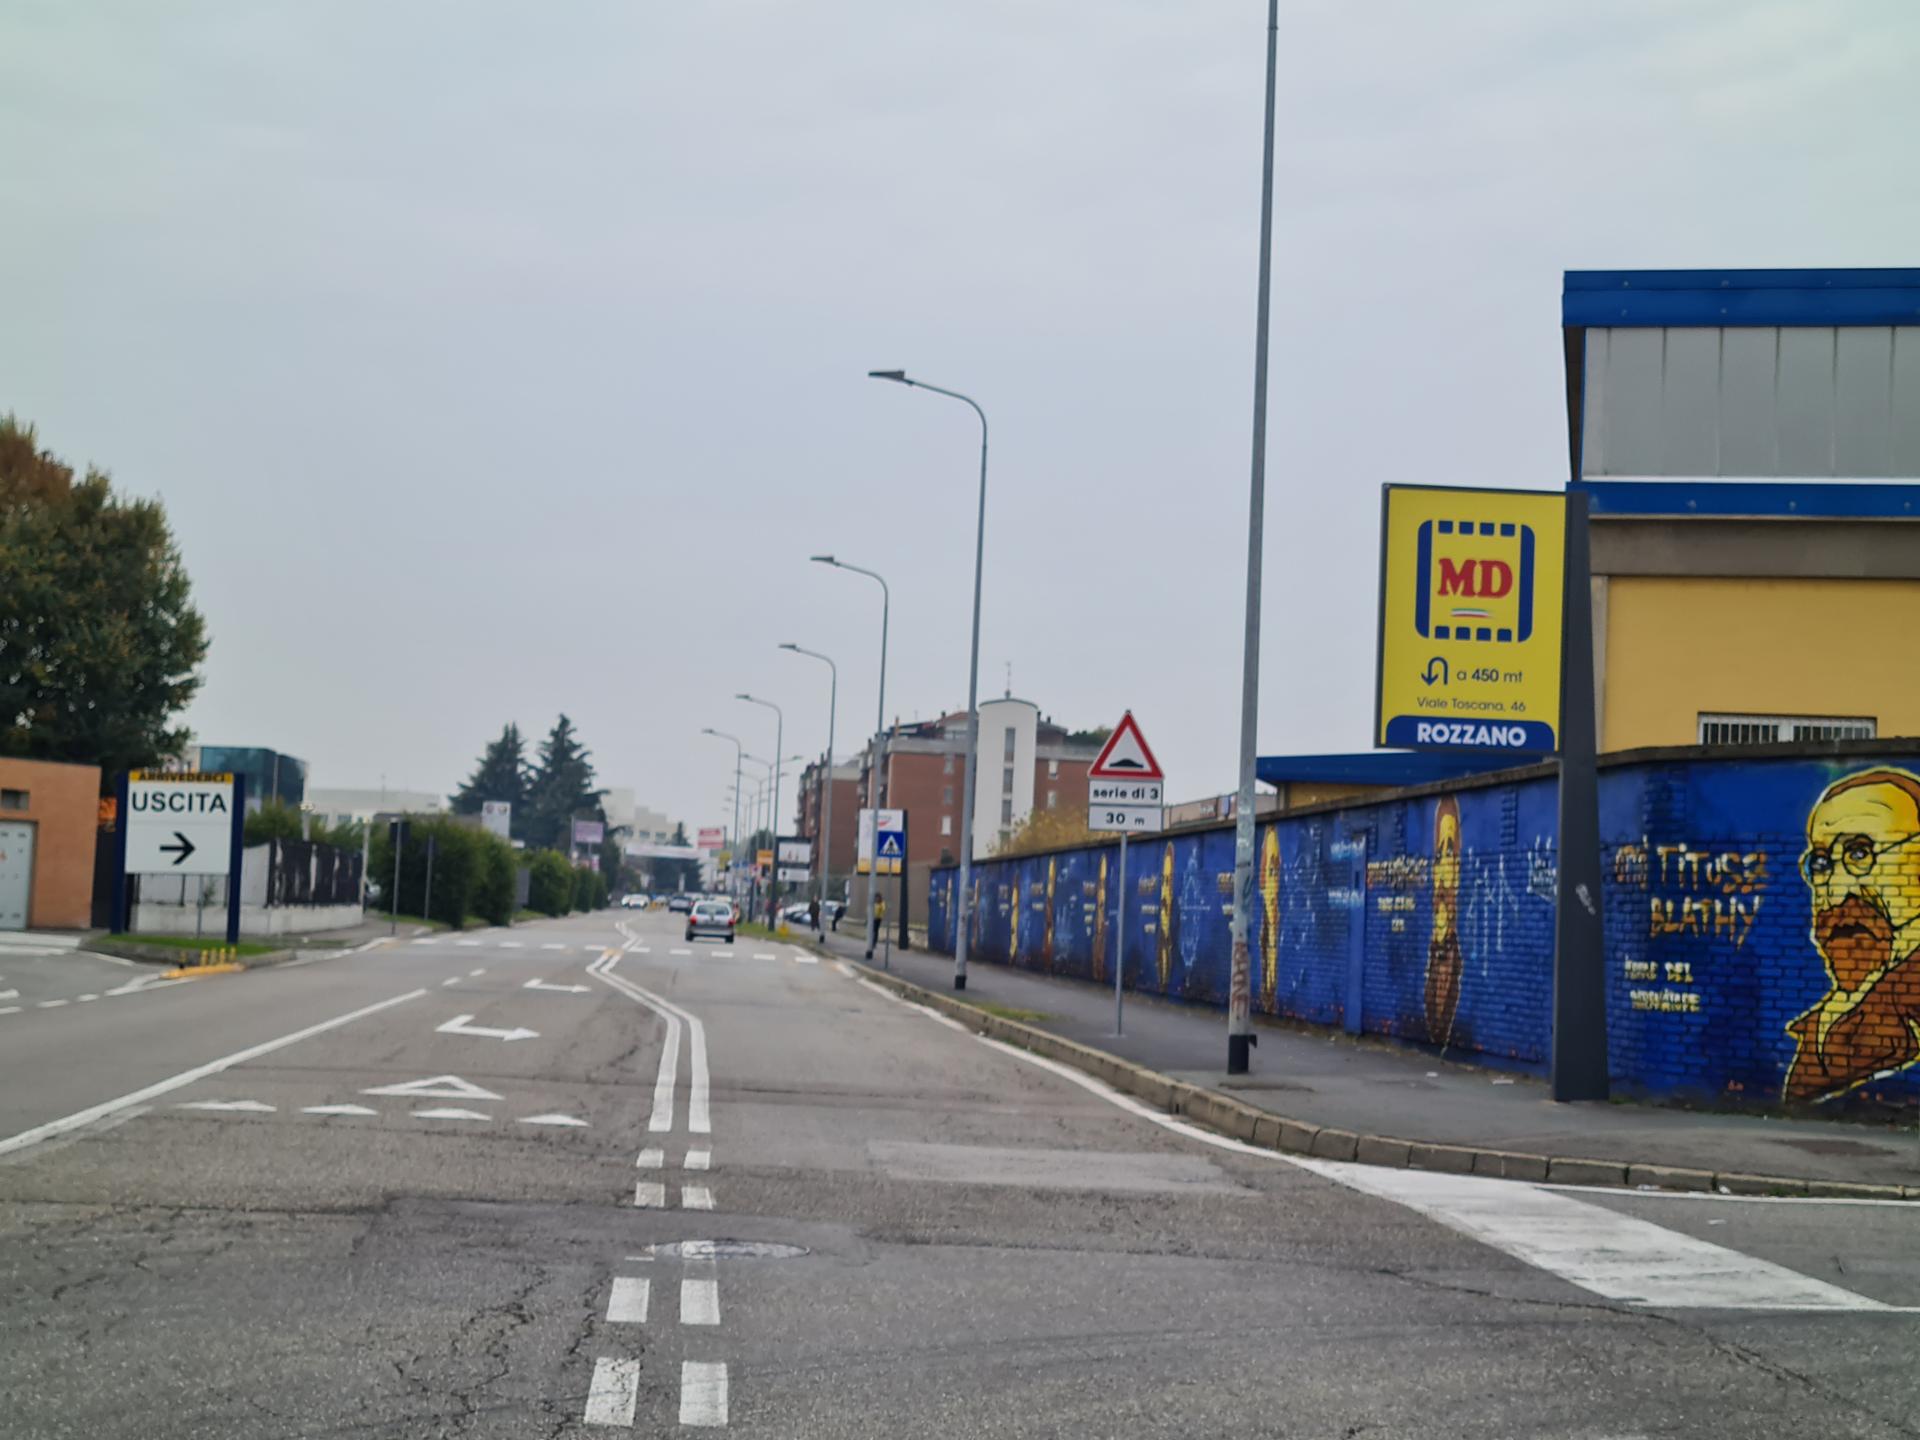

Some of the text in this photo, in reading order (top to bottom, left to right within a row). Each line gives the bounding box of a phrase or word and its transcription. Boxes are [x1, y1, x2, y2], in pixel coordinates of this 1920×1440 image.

[1437, 558, 1513, 598] MD
[1457, 669, 1523, 683] a 450 mt
[1417, 697, 1448, 709] Viale
[1511, 702, 1526, 712] 46
[1417, 723, 1527, 746] ROZZANO
[1093, 787, 1159, 800] serie di 3
[132, 792, 227, 812] USCITA
[1106, 812, 1145, 826] 30 m
